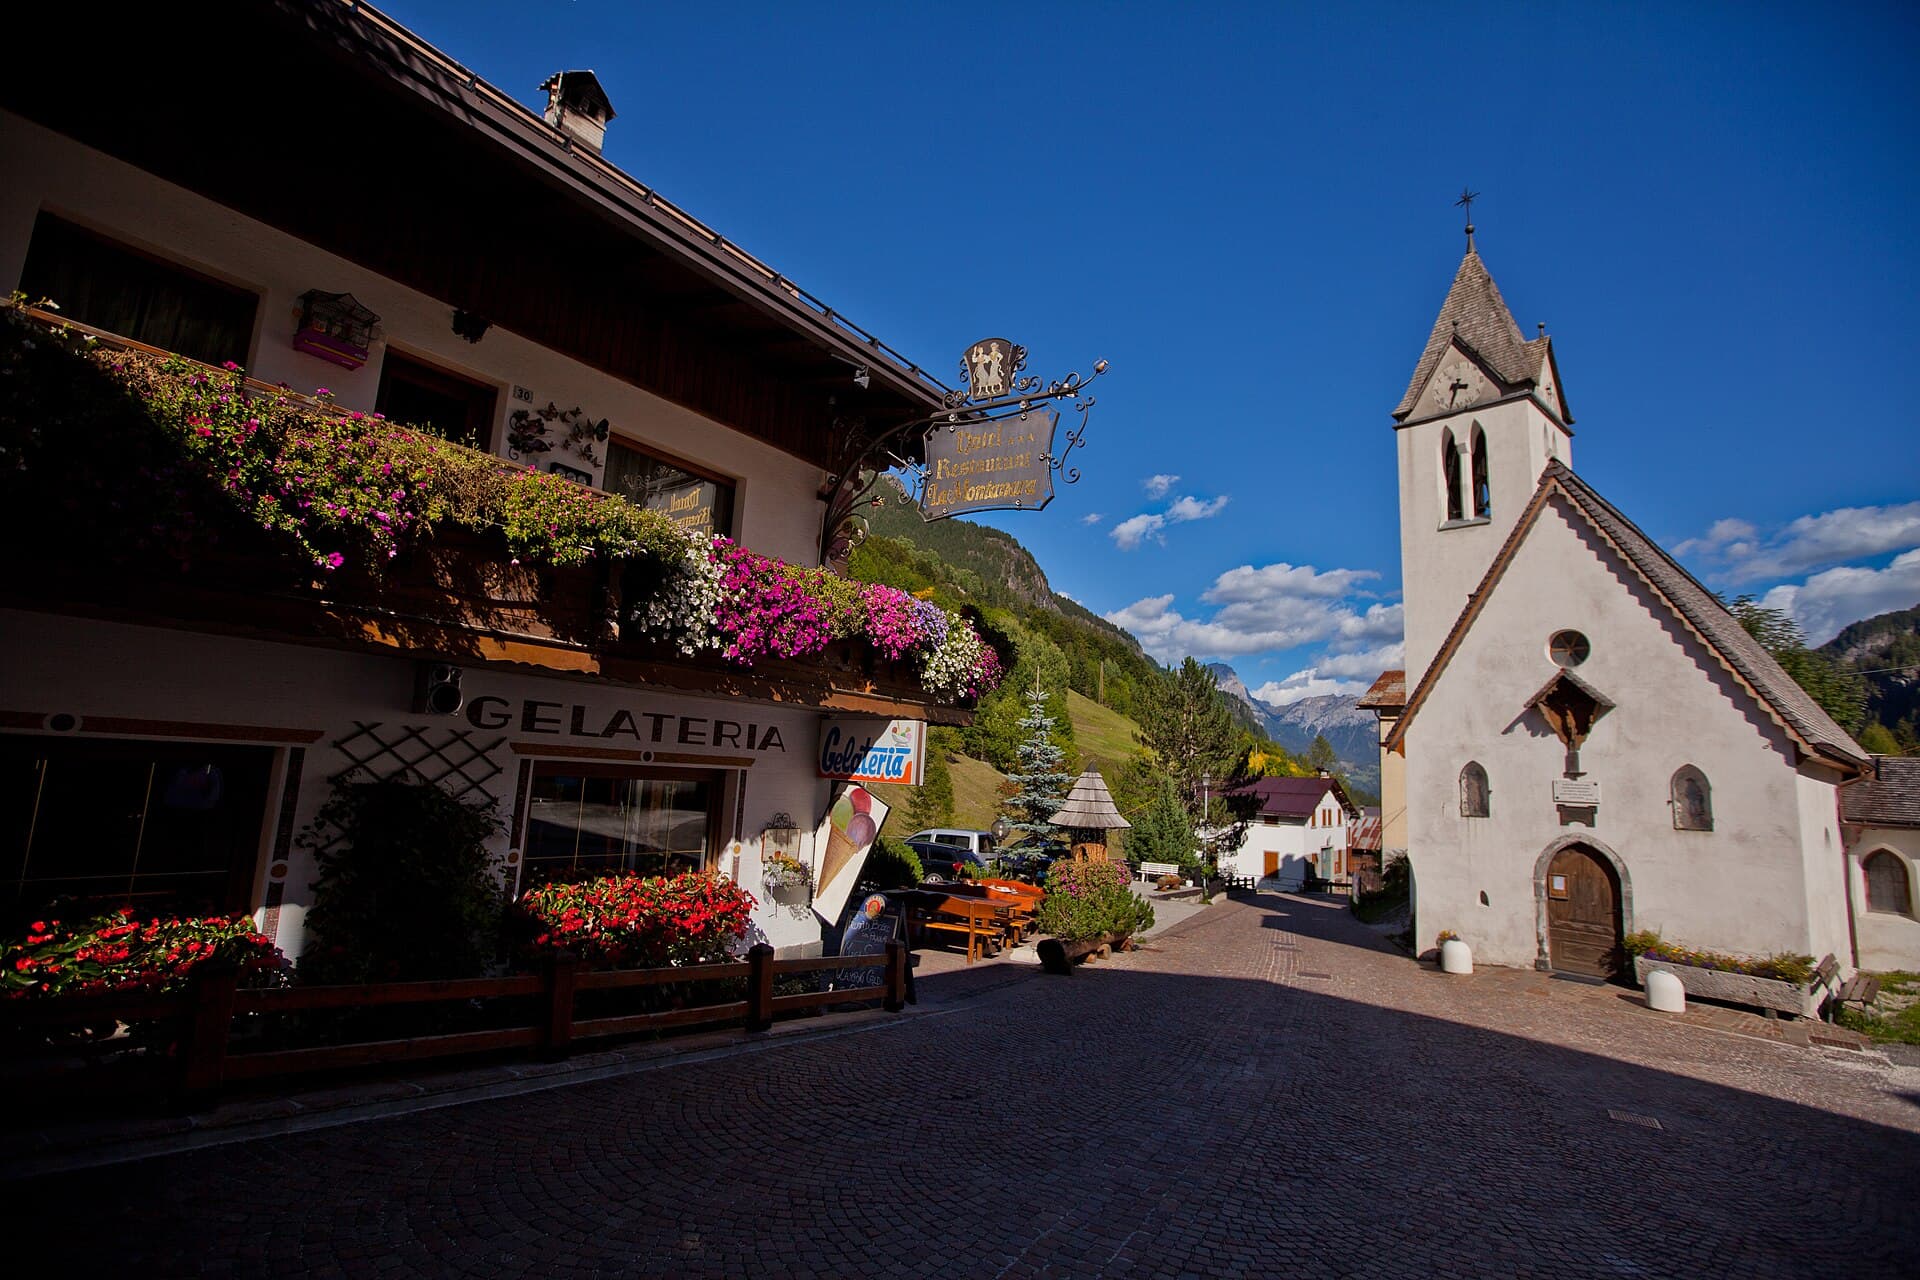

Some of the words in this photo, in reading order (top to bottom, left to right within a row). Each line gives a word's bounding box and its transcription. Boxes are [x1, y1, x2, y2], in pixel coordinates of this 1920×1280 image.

[517, 387, 530, 401] 30
[956, 422, 1002, 455] Hotel
[936, 451, 1031, 481] Restaurant
[466, 695, 786, 752] GELATERIA
[821, 726, 911, 777] Gelateria
